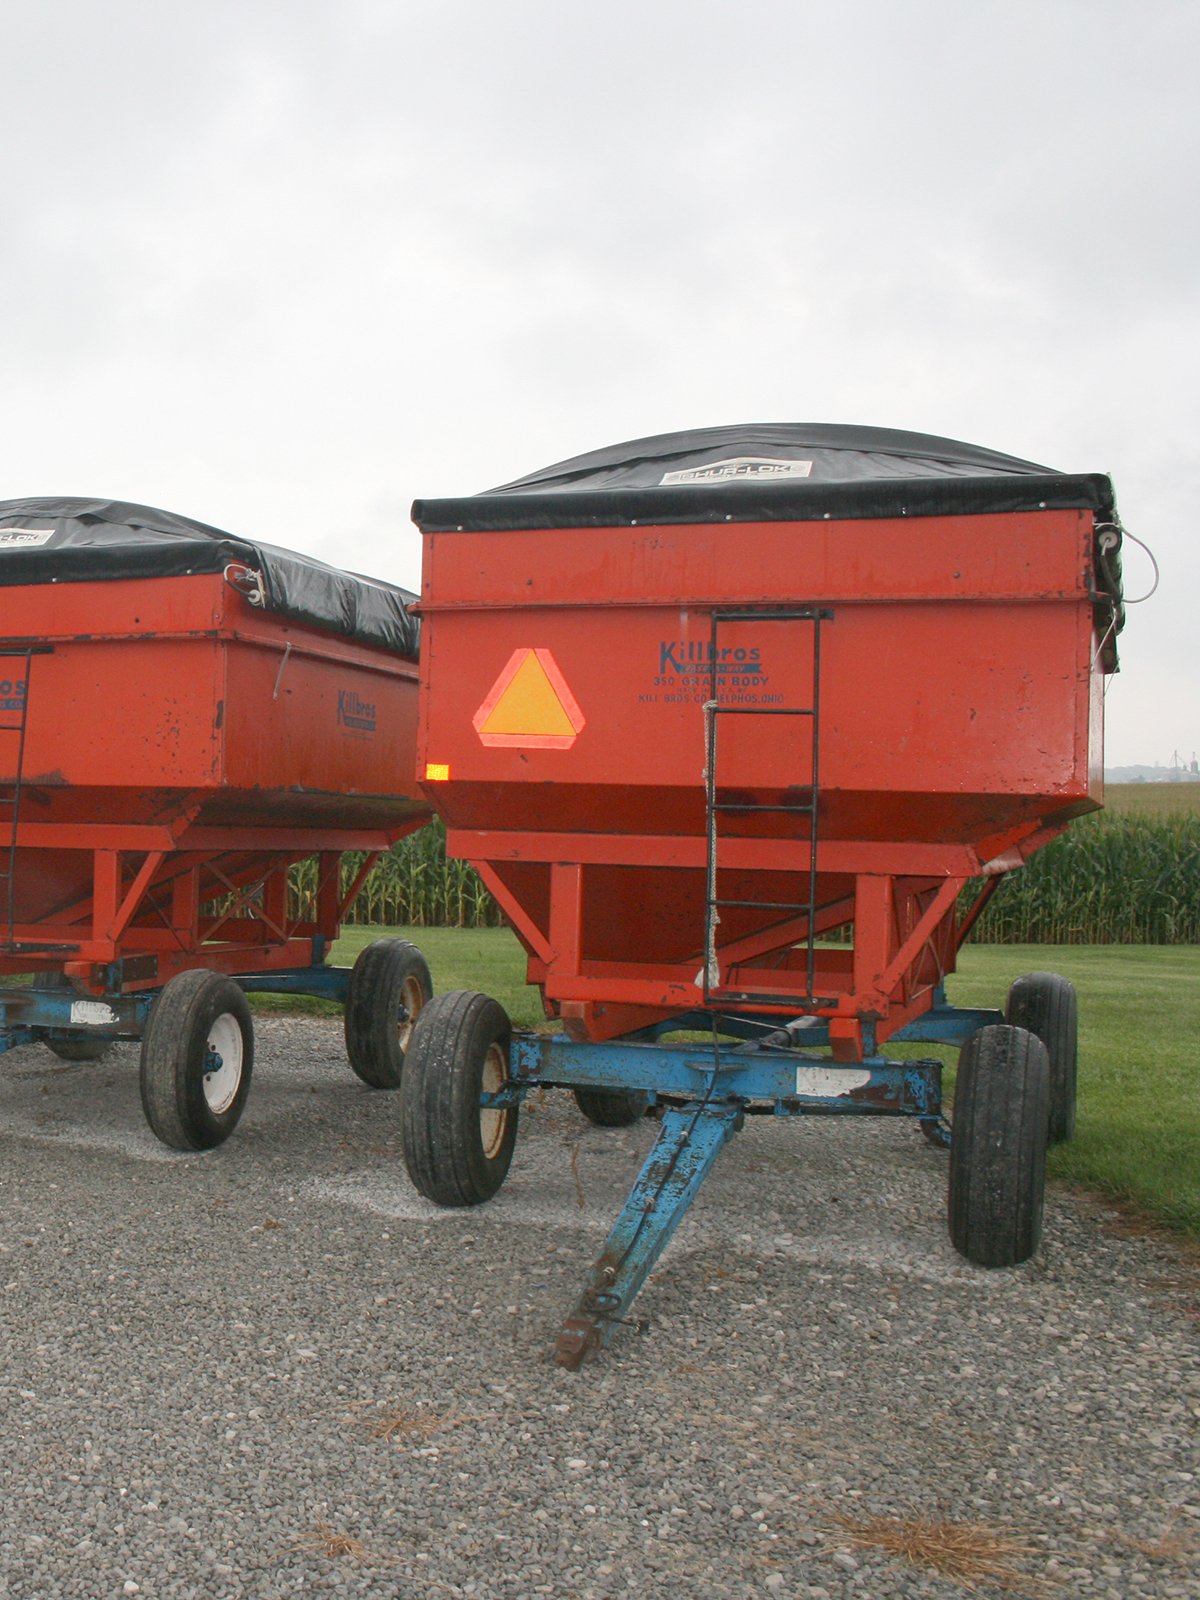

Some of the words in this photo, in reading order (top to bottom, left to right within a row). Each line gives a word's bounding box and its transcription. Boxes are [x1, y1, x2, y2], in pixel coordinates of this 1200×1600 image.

[660, 641, 762, 674] Killbros
[682, 677, 726, 686] GRAN
[731, 677, 769, 686] BODY
